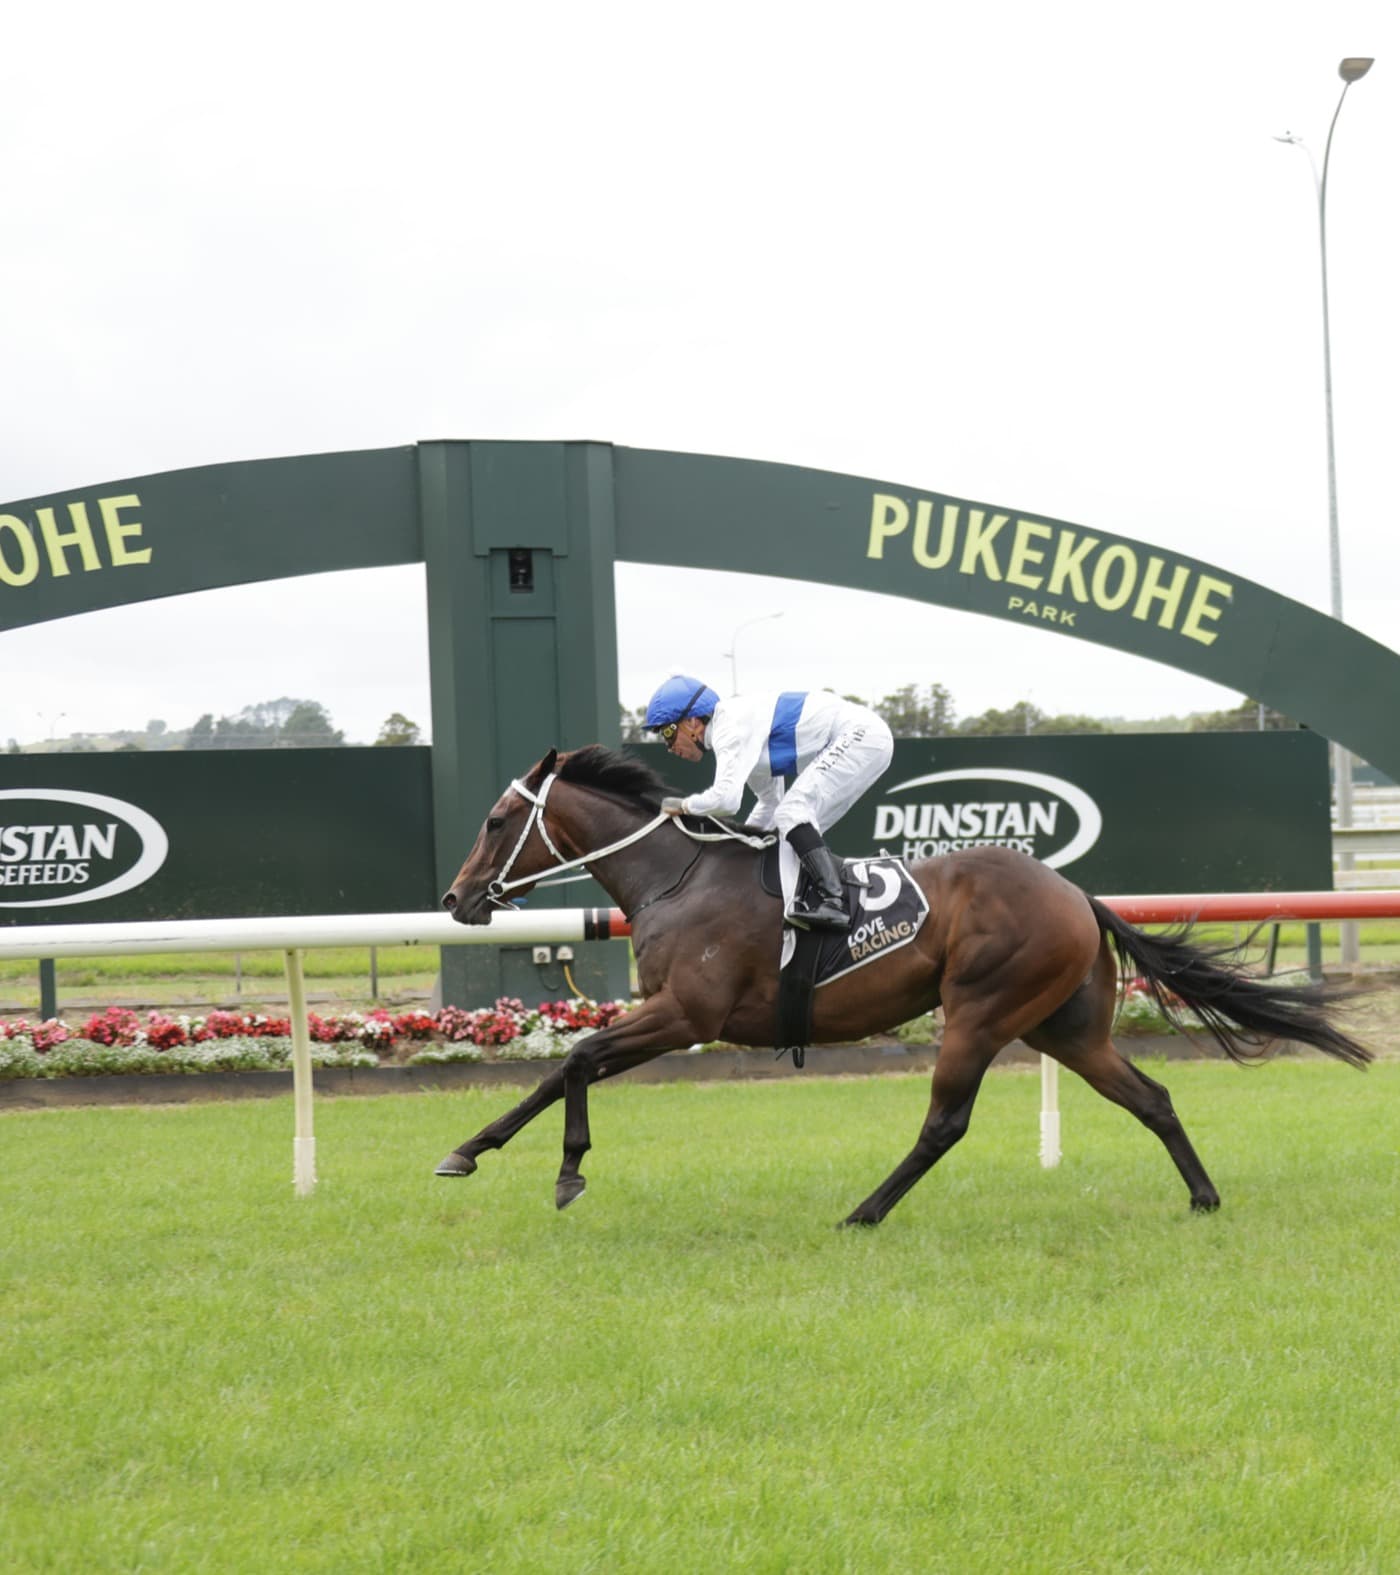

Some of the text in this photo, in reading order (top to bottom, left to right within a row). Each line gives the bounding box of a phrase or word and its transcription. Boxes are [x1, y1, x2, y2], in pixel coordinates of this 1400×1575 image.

[866, 493, 1233, 646] PUKEKOHE
[1008, 596, 1077, 627] PARK
[873, 802, 1059, 840] DUNSTAN
[0, 824, 118, 863] STAN
[848, 916, 886, 948] LOVE
